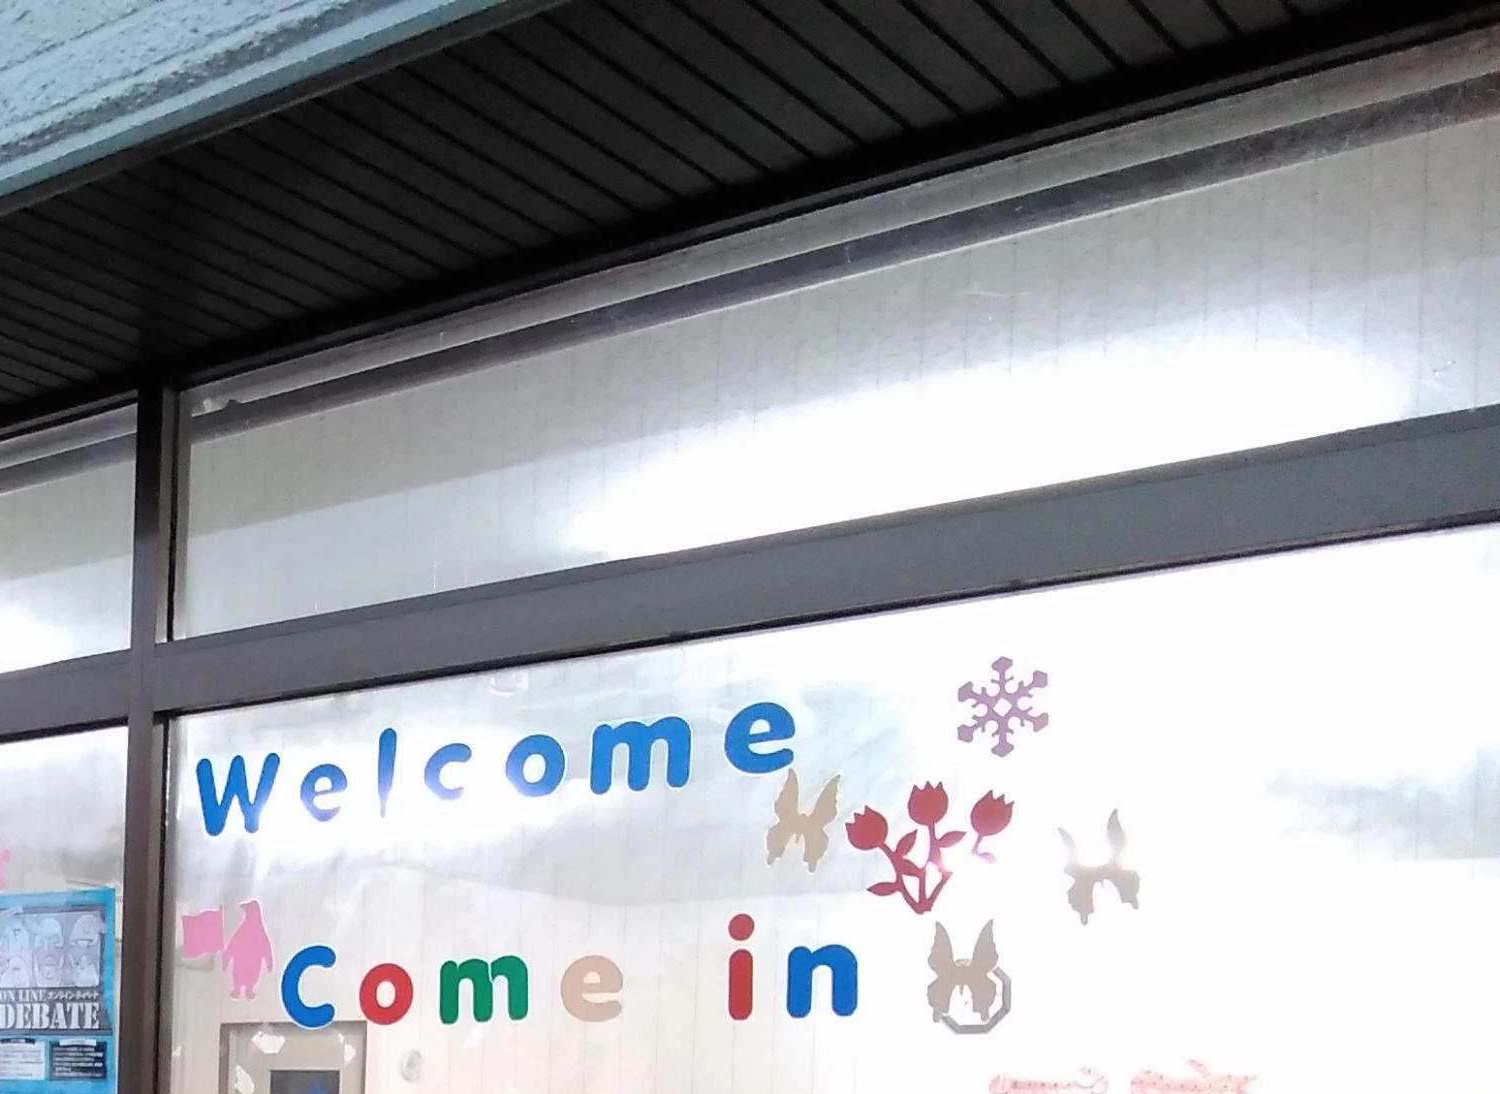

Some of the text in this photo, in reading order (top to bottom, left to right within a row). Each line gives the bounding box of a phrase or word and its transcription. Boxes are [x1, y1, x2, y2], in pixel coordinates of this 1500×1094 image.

[195, 702, 796, 836] Welcome
[0, 989, 46, 1002] ON LINE
[727, 912, 858, 1021] in
